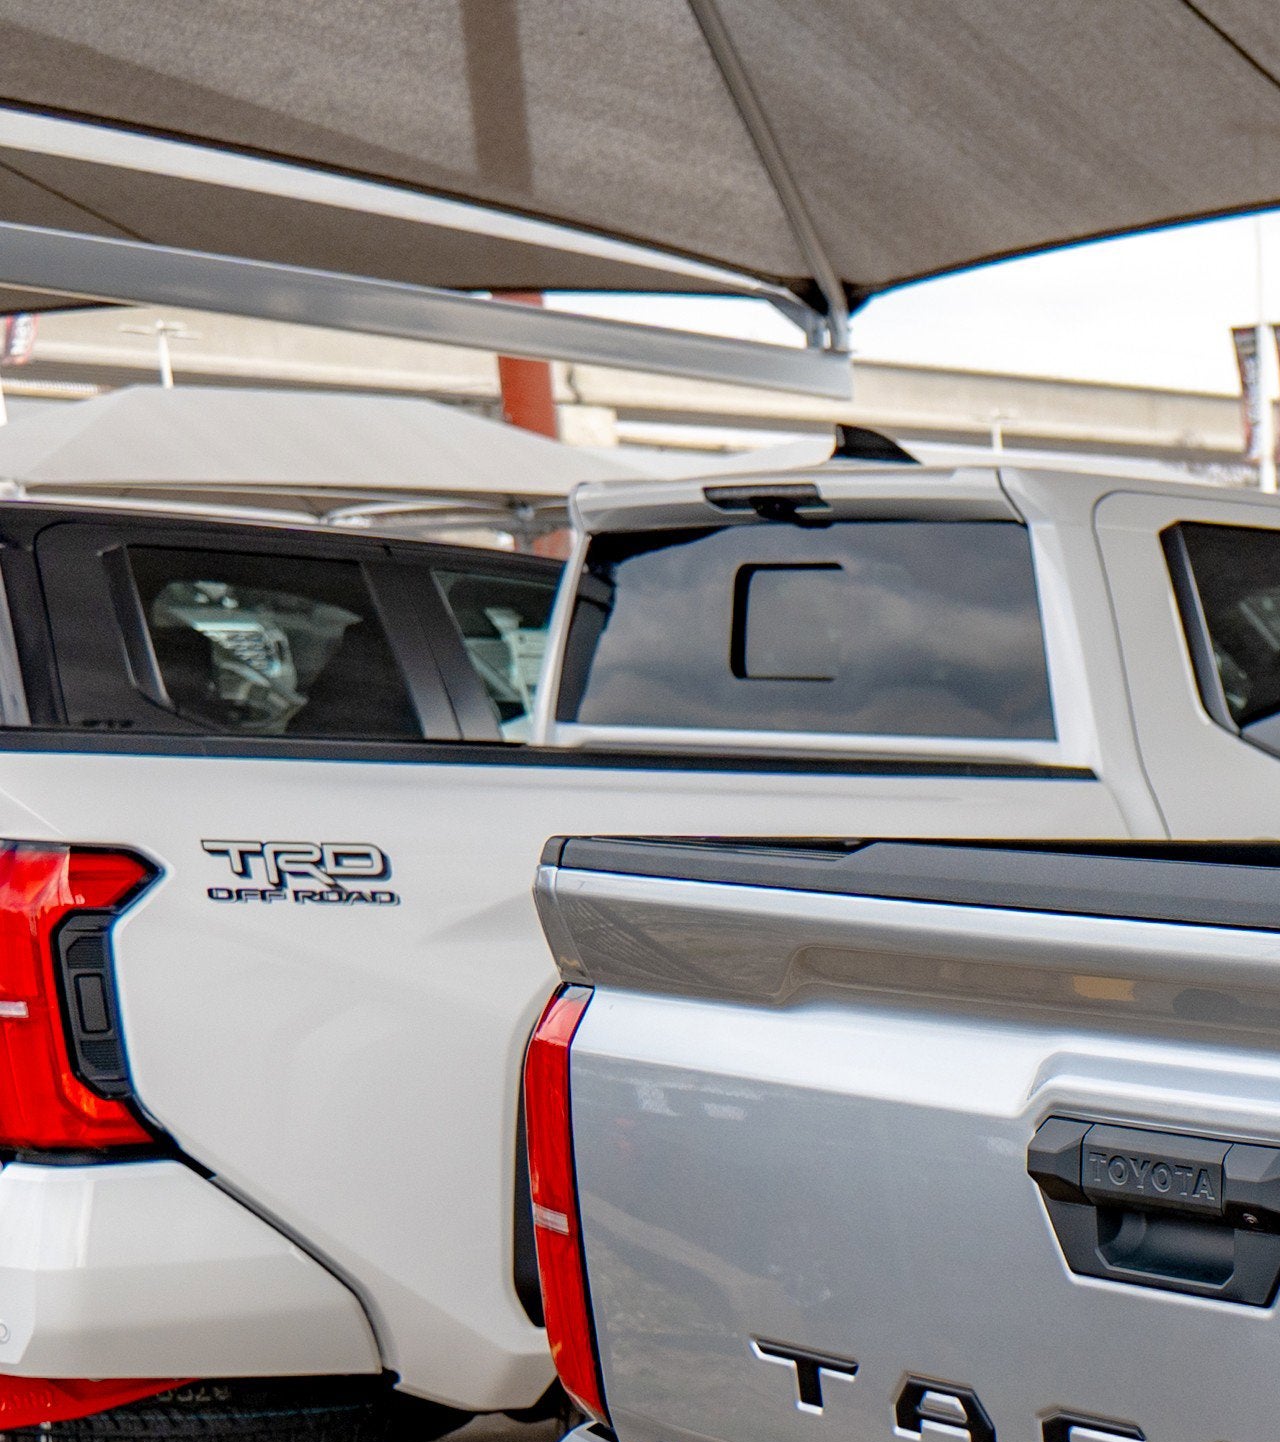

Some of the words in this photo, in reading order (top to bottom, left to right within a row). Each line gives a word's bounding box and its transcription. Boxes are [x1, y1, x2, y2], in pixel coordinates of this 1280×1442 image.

[201, 839, 392, 890] TRD
[207, 887, 287, 903] OFF
[293, 889, 401, 906] ROAD
[1088, 1151, 1216, 1201] TOYOTA
